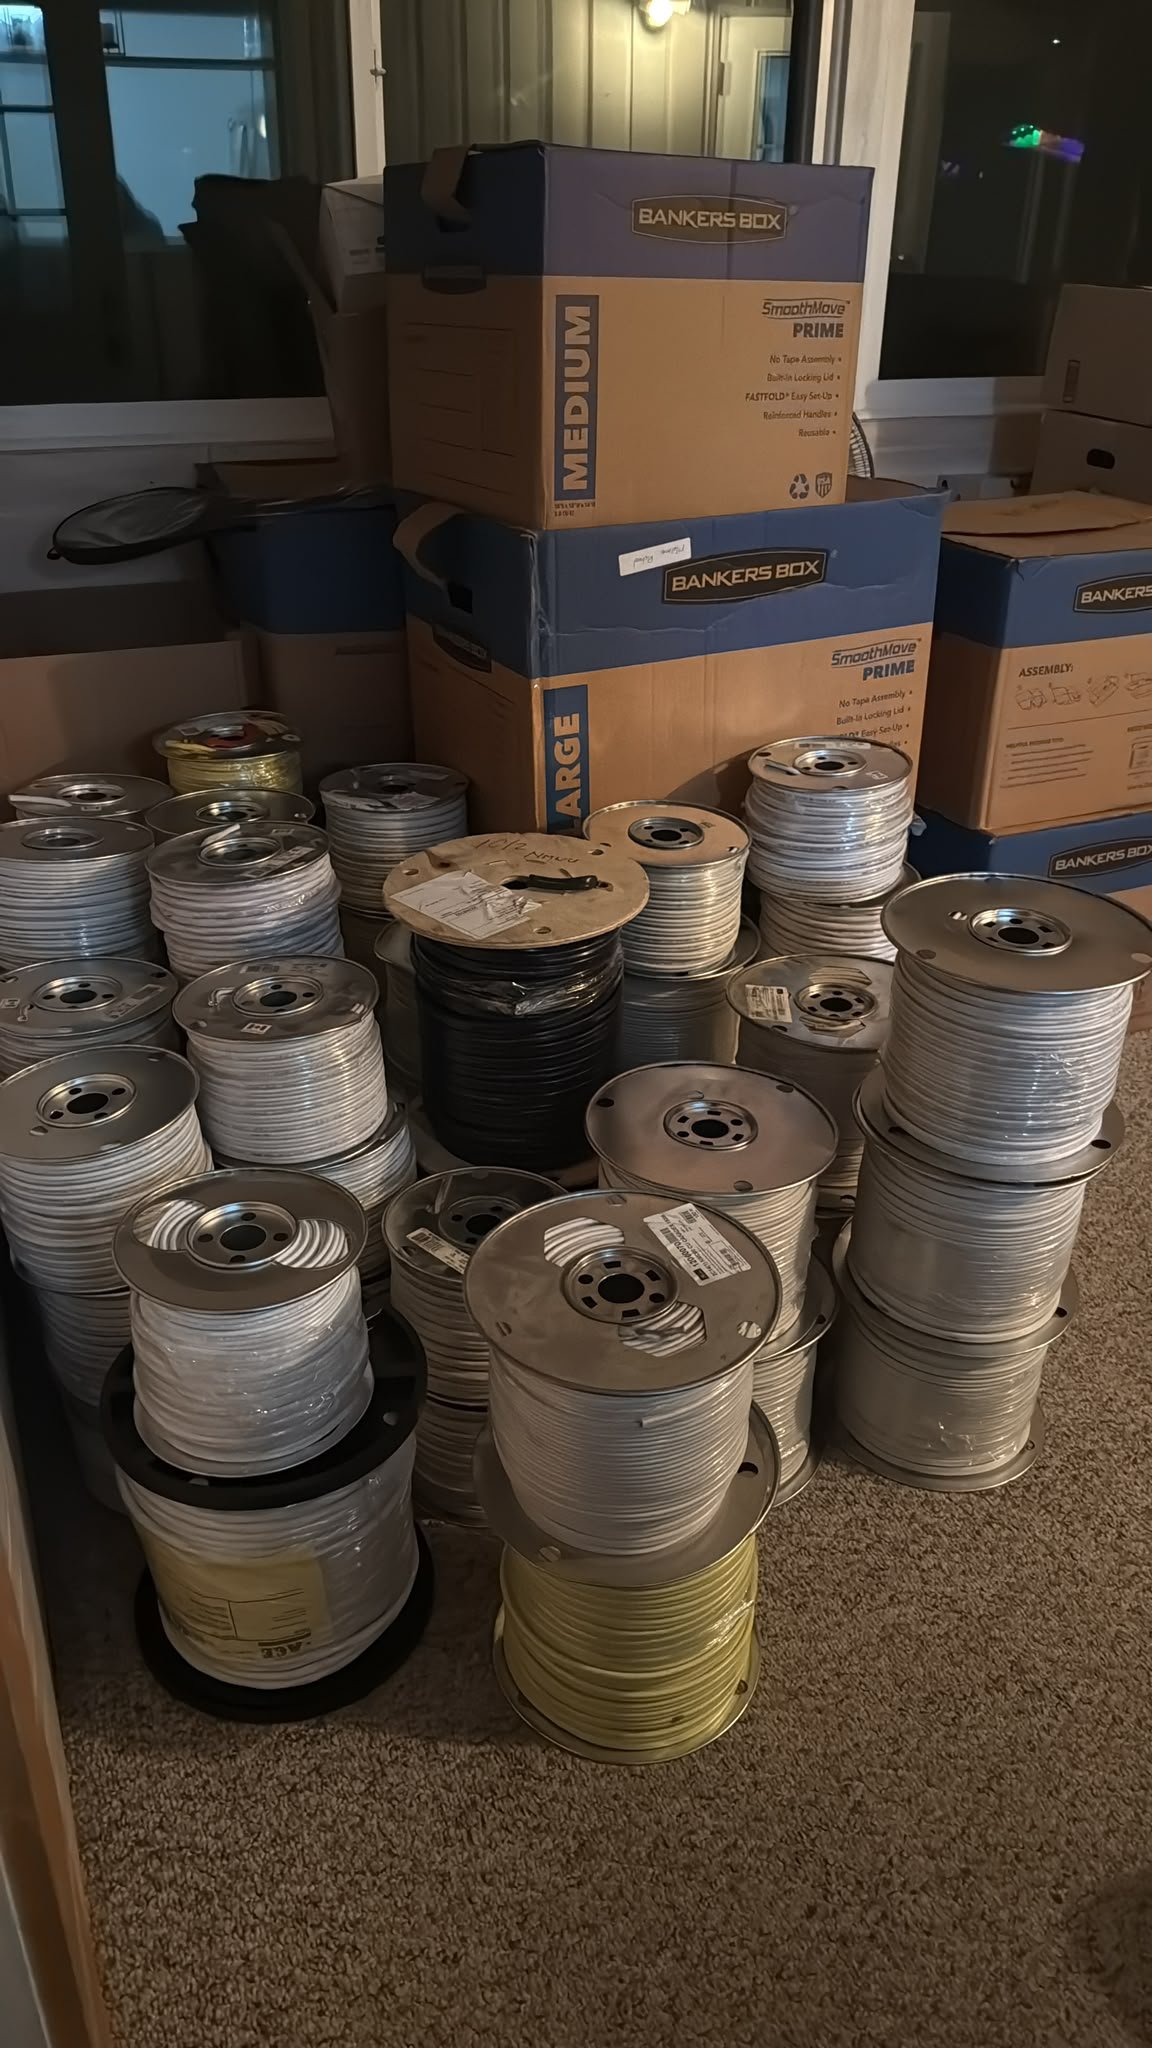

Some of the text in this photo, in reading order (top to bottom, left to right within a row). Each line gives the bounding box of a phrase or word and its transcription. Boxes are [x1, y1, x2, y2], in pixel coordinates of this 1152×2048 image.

[638, 208, 782, 230] BANKERS BOX
[761, 301, 846, 316] SmoothMove
[793, 322, 844, 339] PRIME
[769, 354, 835, 365] No Tape Assembly
[794, 373, 821, 384] Locking
[823, 373, 834, 381] Lid
[562, 306, 591, 491] MEDIUM
[791, 392, 808, 402] Easy
[808, 391, 833, 401] Set-Up
[803, 410, 831, 419] Handles
[798, 428, 830, 438] Reusable
[671, 559, 820, 592] BANKERS BOX
[1080, 584, 1152, 604] BANKERS
[831, 641, 917, 667] SmoothMove
[862, 659, 915, 681] PRIME
[1018, 662, 1074, 678] ASSEMBLY:
[838, 689, 906, 709] No Tape Assembly
[863, 709, 892, 721] Locking
[893, 705, 905, 715] Lid
[860, 728, 878, 738] Easy
[879, 723, 903, 735] Set-Up
[1055, 848, 1126, 871] BANKERS
